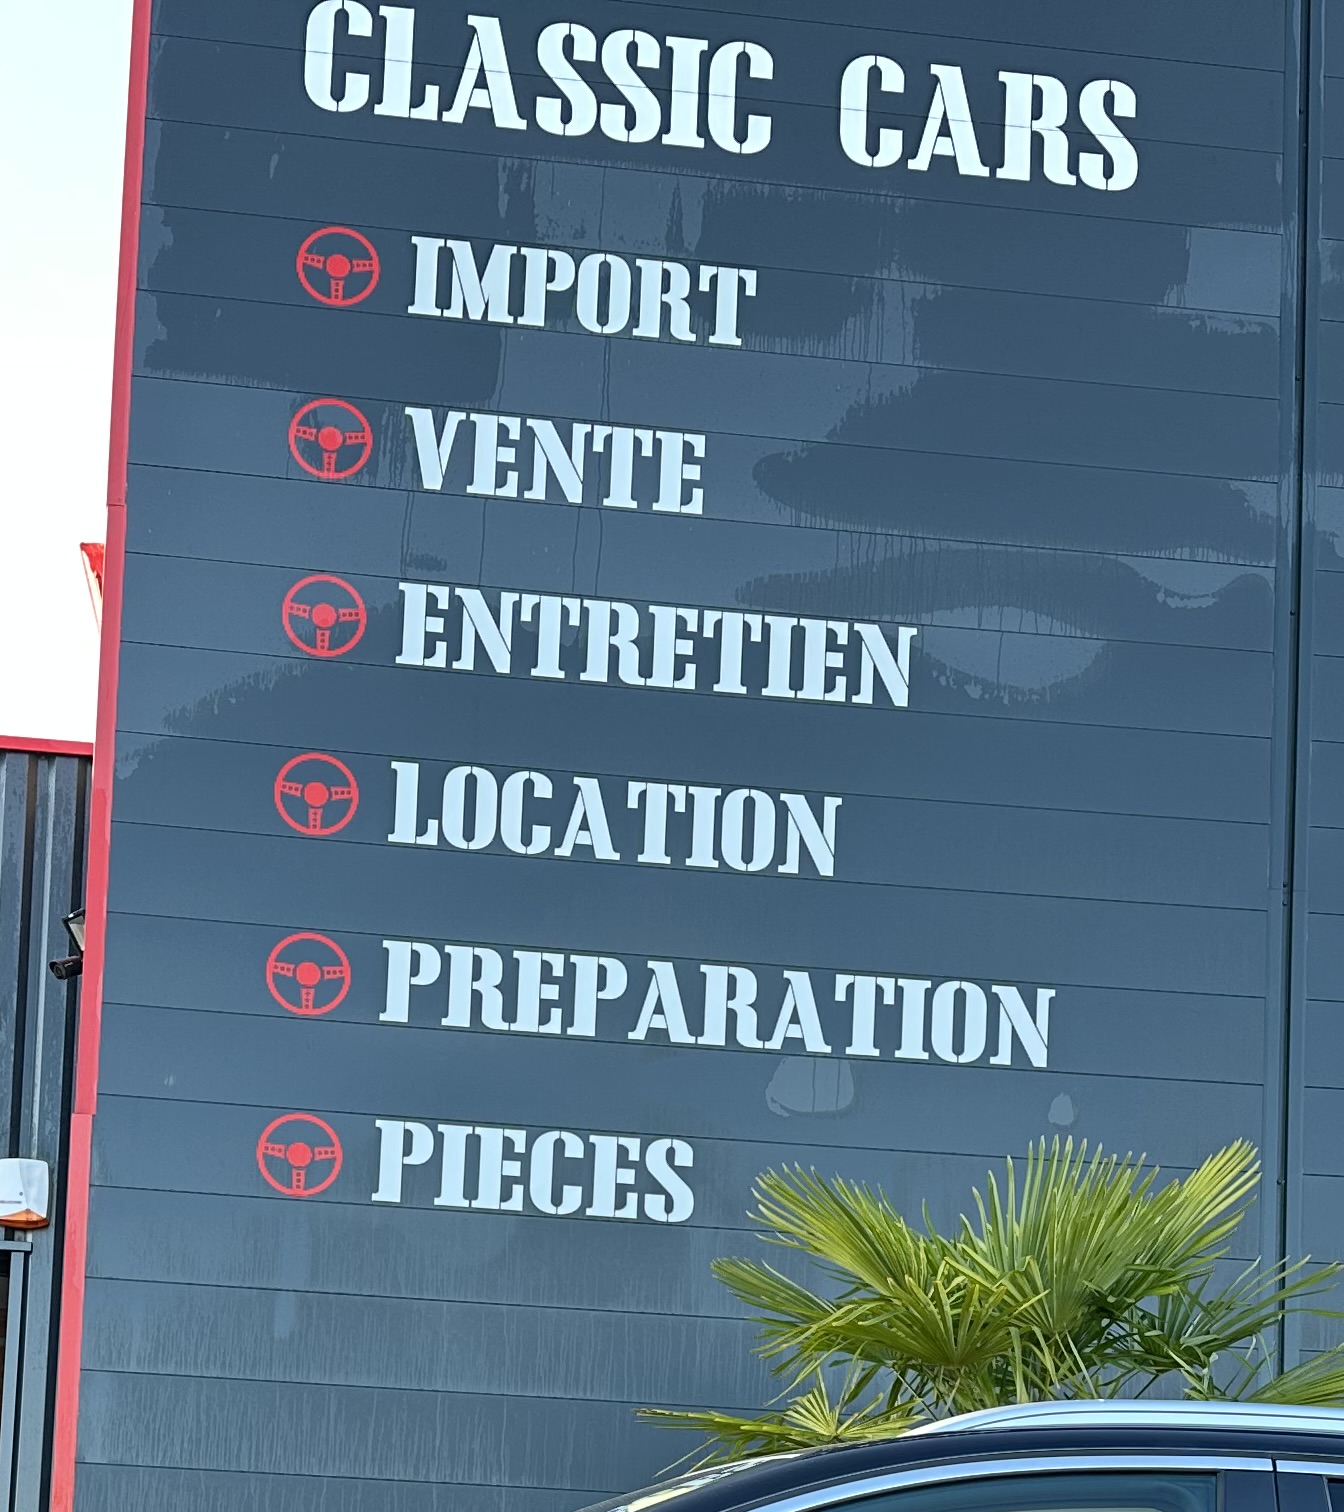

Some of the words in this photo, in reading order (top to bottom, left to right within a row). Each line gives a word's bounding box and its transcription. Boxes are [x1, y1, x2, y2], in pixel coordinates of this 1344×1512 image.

[304, 0, 774, 154] CLASSIC
[839, 55, 1138, 191] CARS
[407, 236, 757, 346] IMPORT
[404, 406, 706, 515] VENTE
[395, 582, 918, 707] ENTRETIEN
[387, 761, 843, 877] LOCATION
[379, 940, 1056, 1068] PREPARATION
[371, 1119, 694, 1223] PIECES
